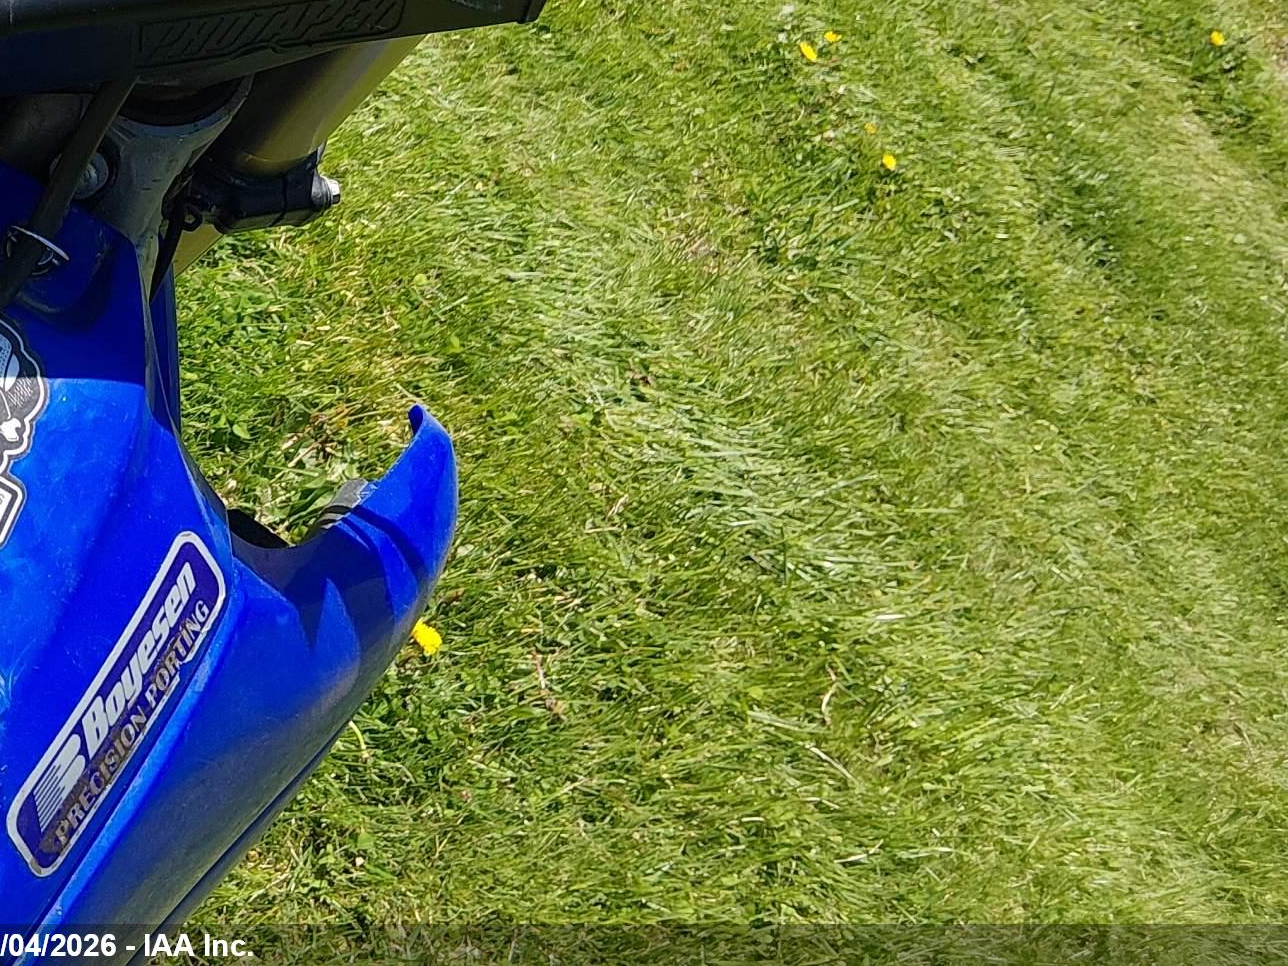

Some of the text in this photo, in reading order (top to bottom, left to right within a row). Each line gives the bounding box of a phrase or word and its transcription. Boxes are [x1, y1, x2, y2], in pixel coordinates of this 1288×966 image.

[54, 599, 211, 848] PRECISION PORTING
[80, 560, 197, 760] Boyesen
